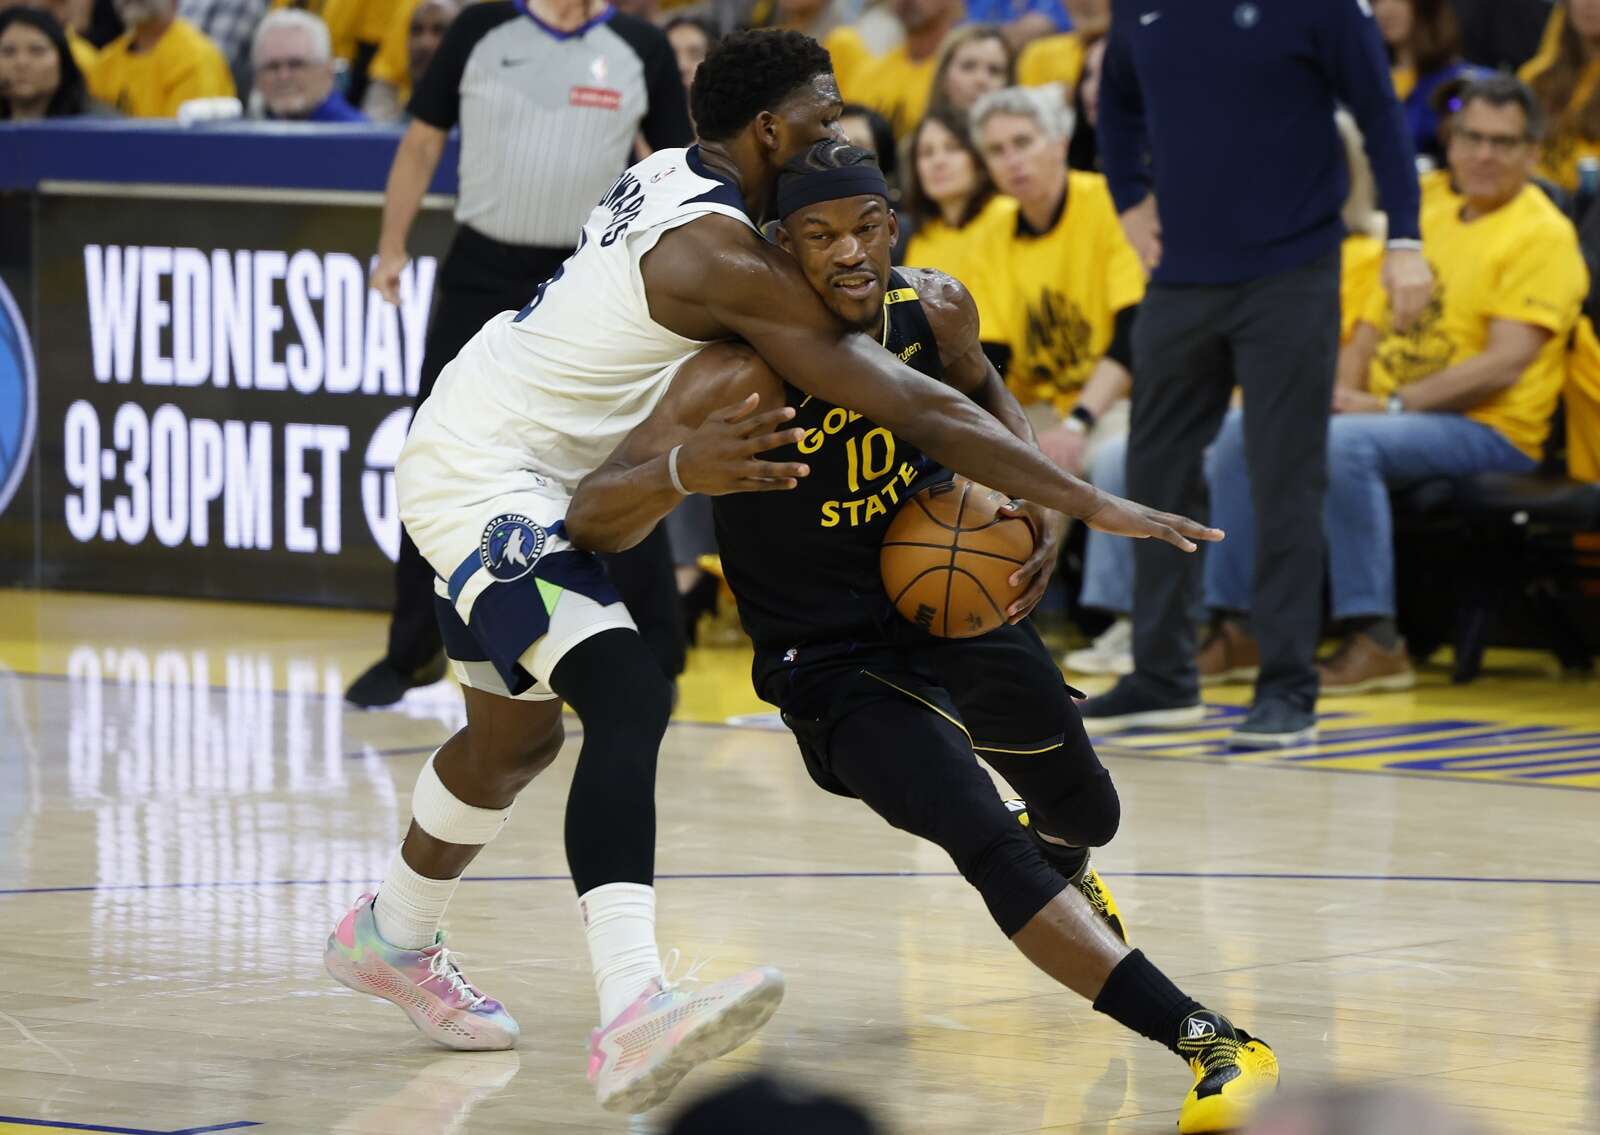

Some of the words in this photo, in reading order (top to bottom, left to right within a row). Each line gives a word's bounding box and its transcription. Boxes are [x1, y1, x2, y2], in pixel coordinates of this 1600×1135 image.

[83, 243, 438, 397] WEDNESDAY
[887, 291, 900, 302] 16
[63, 399, 273, 550] 9:30PM
[284, 423, 350, 555] ET
[845, 426, 896, 493] 10
[819, 461, 919, 528] STATE
